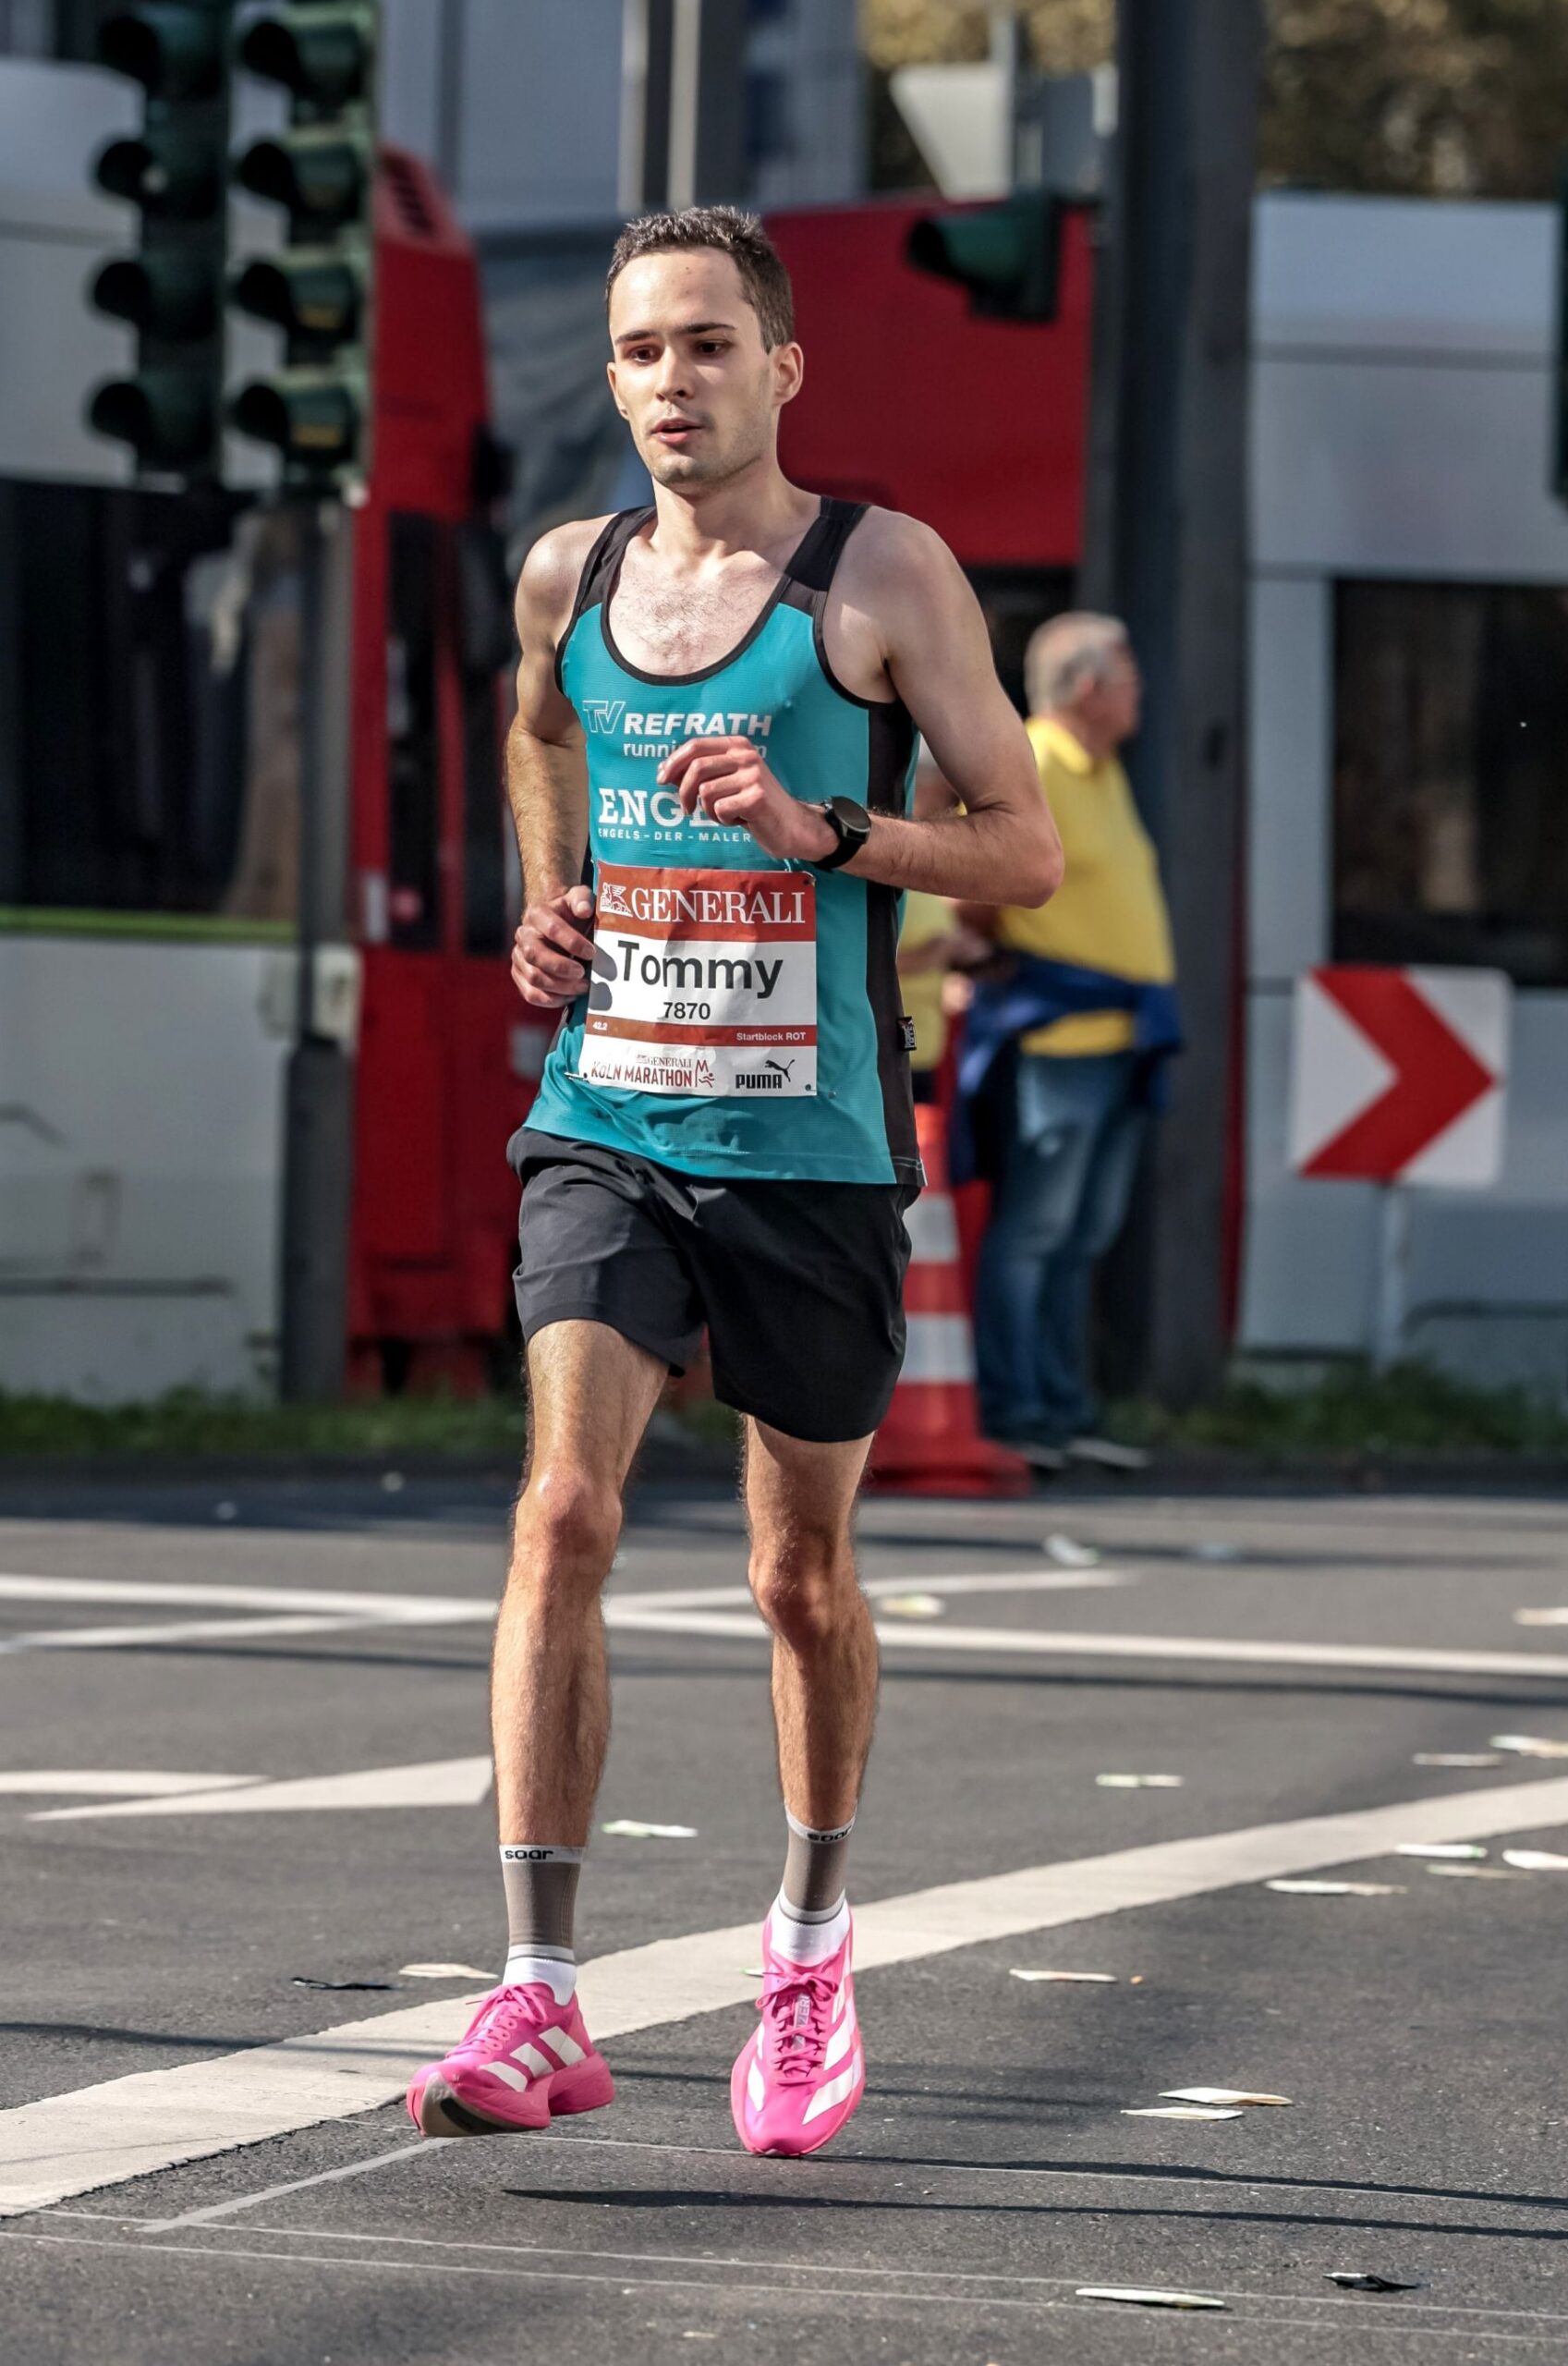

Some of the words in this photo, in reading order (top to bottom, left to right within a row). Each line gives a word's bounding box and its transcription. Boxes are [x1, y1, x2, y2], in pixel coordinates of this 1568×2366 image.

[582, 700, 626, 734] TV
[624, 713, 772, 737] REFRATH
[623, 740, 681, 759] runni
[630, 886, 806, 925] GENERALI
[617, 939, 784, 999] Tommy
[662, 1001, 711, 1020] 7870
[735, 1031, 784, 1043] Startblock
[786, 1031, 807, 1042] ROT
[623, 1065, 692, 1088] MARATHON
[735, 1074, 783, 1090] PUMA
[504, 1849, 554, 1860] soar
